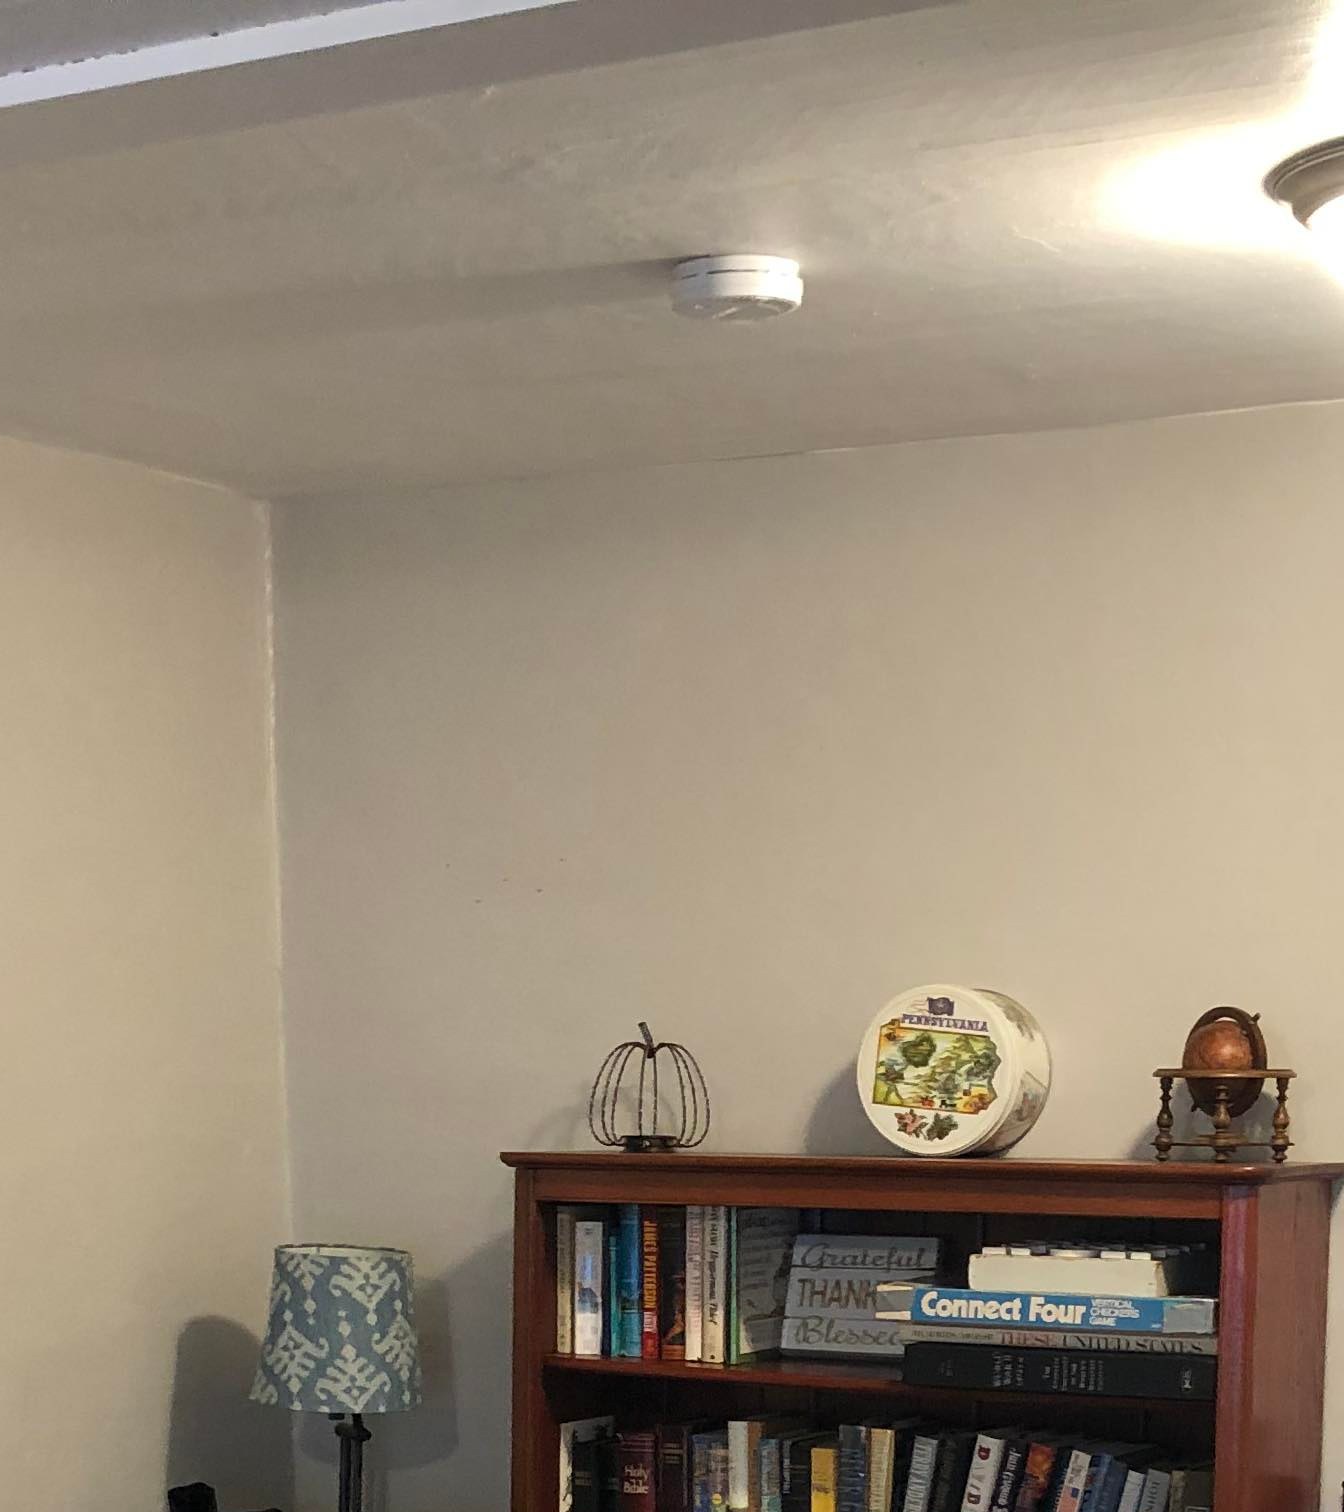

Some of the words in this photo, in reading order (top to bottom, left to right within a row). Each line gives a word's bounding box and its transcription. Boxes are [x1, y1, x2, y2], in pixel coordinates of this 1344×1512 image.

[902, 1013, 989, 1033] PENNSYLVANIA
[800, 1242, 926, 1274] Grateful
[642, 1255, 657, 1308] PATTERSON
[797, 1278, 878, 1310] THANK
[921, 1291, 1022, 1321] Connect
[1029, 1296, 1086, 1325] Four
[1001, 1332, 1057, 1347] THESE
[1062, 1335, 1130, 1351] UNITED
[1134, 1338, 1204, 1354] STATES
[624, 1464, 650, 1481] Holy
[623, 1479, 649, 1494] Bible
